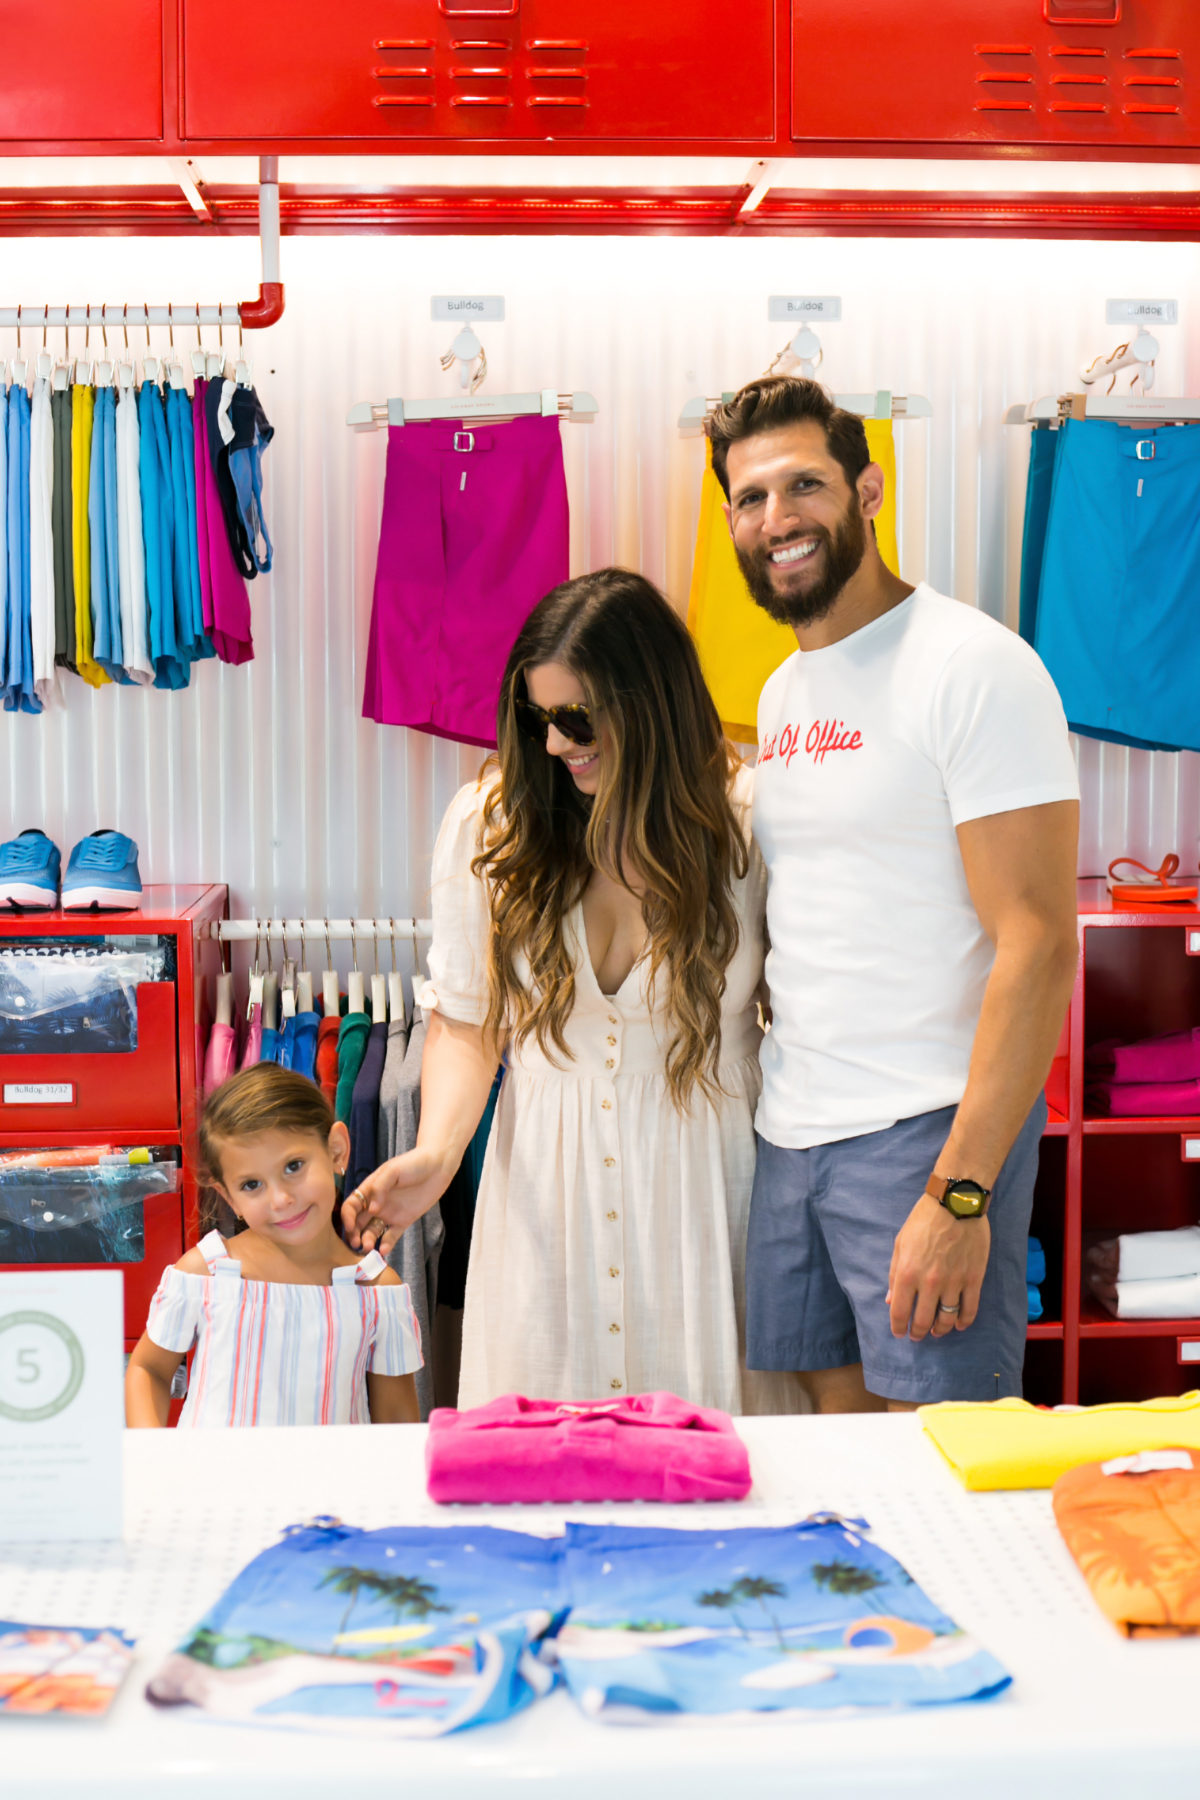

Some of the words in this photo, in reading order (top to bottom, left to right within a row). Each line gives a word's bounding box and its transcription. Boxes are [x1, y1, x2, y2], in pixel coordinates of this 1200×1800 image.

[447, 300, 484, 312] Bulldog
[779, 723, 800, 769] Of
[805, 717, 863, 766] Office
[14, 1085, 43, 1094] Bulldog
[16, 1347, 41, 1384] 5
